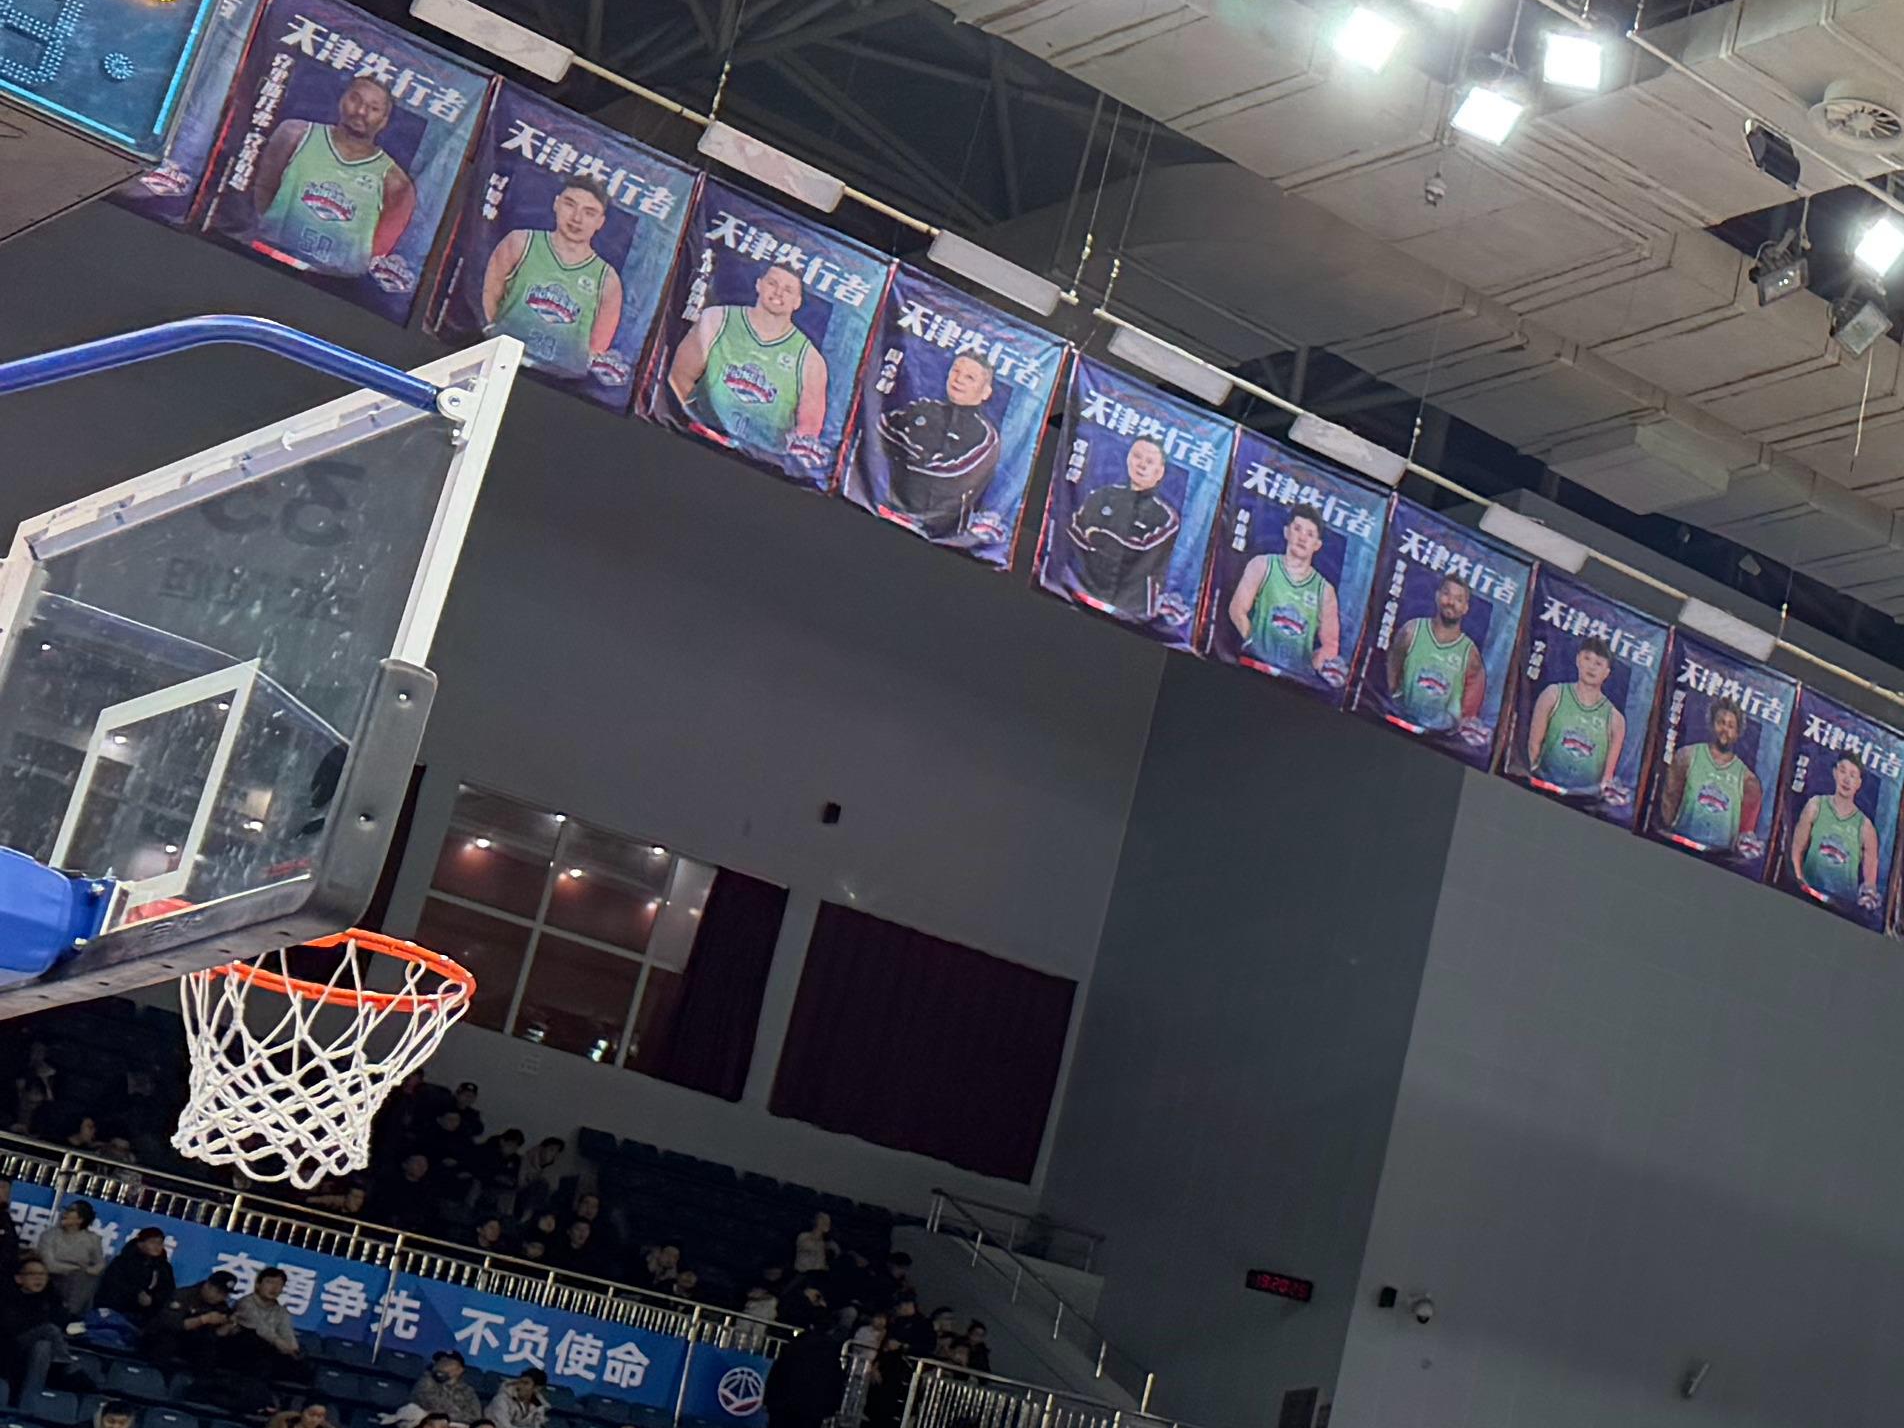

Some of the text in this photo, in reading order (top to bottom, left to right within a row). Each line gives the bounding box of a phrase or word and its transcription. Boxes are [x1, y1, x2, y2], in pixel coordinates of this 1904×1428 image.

[280, 13, 469, 124] 天津先行者
[501, 119, 677, 220] 天津先行者
[704, 210, 872, 308] 天津先行者
[897, 300, 1045, 390] 天津先行者
[1080, 389, 1219, 472] 天津先行者
[1243, 462, 1375, 539] 天津先行者
[1399, 528, 1519, 605] 天津先行者
[1540, 596, 1654, 668] 天津先行者
[1676, 658, 1785, 725] 天津先行者
[455, 1307, 651, 1389] 不负使命
